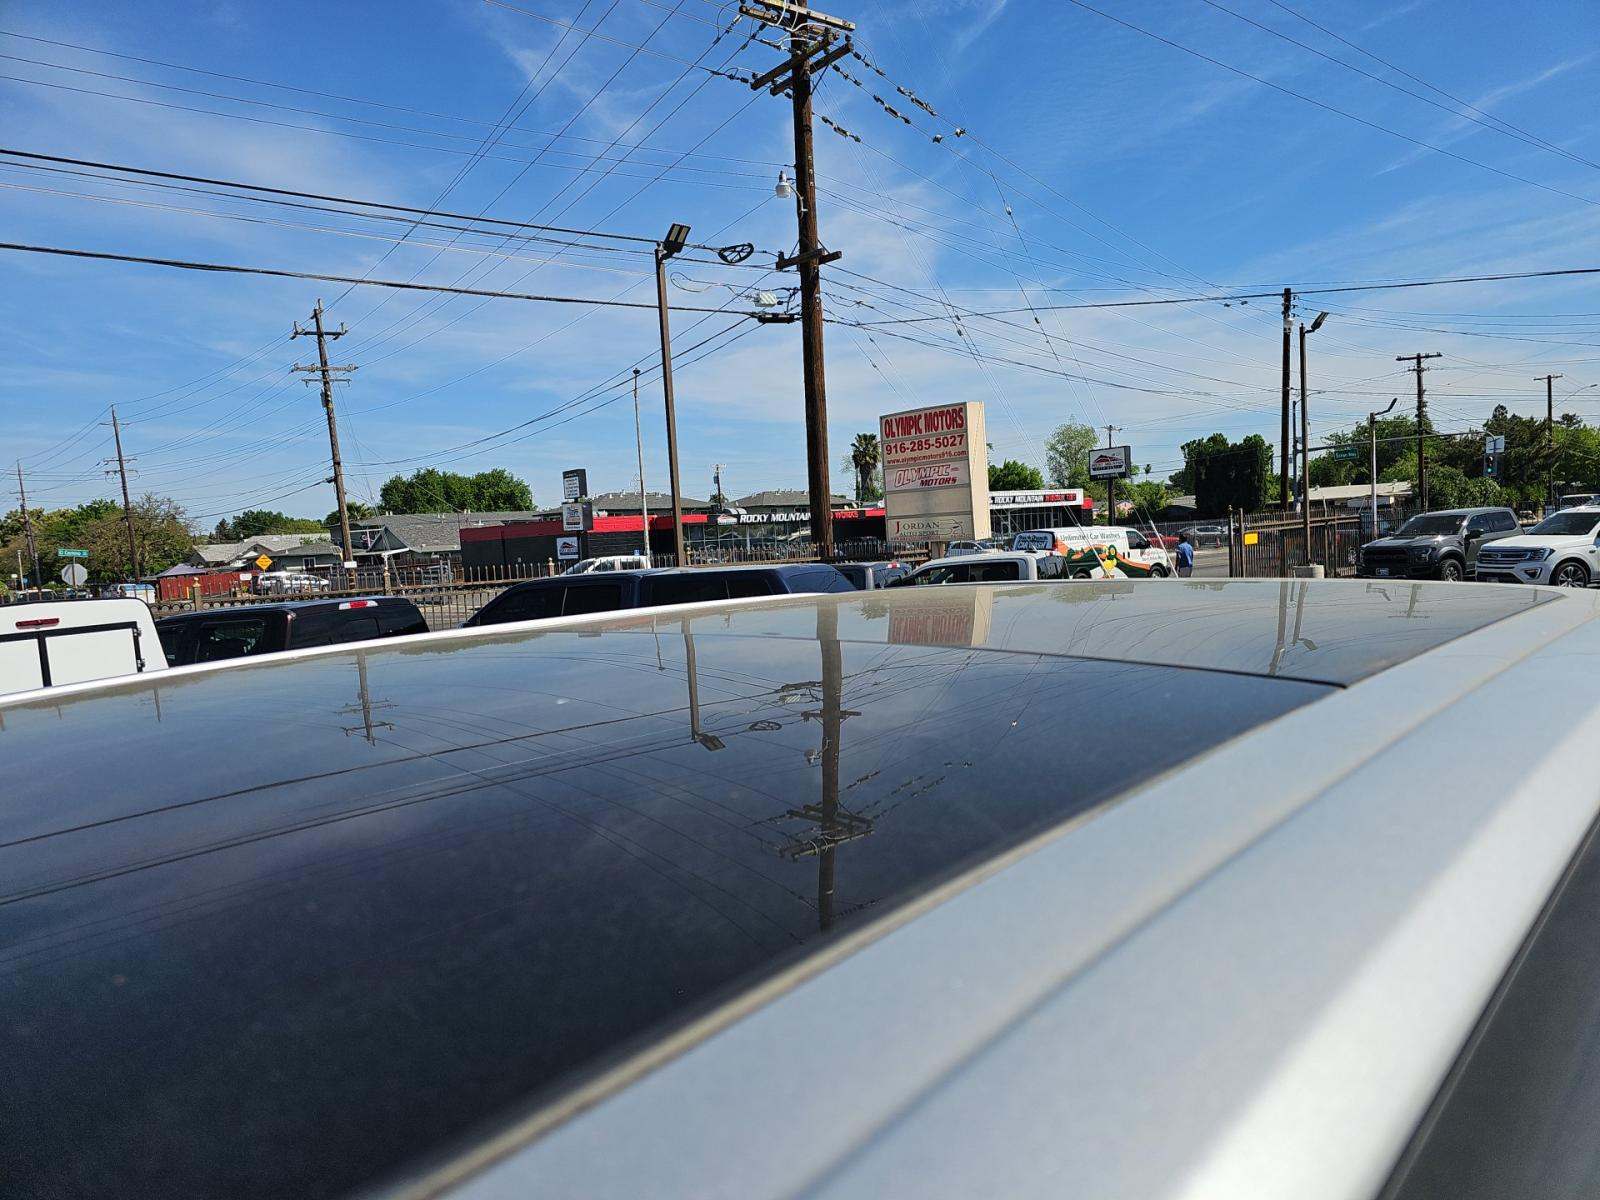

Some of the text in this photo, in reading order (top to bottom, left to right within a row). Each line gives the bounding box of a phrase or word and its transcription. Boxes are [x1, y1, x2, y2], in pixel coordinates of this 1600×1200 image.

[884, 407, 964, 438] OLYMPIC MOTORS
[885, 435, 964, 455] 916-285-5027
[894, 464, 951, 487] OLYMPIC
[919, 476, 957, 487] MOTORS
[740, 514, 769, 523] ROCKY
[896, 521, 940, 535] JORDAN
